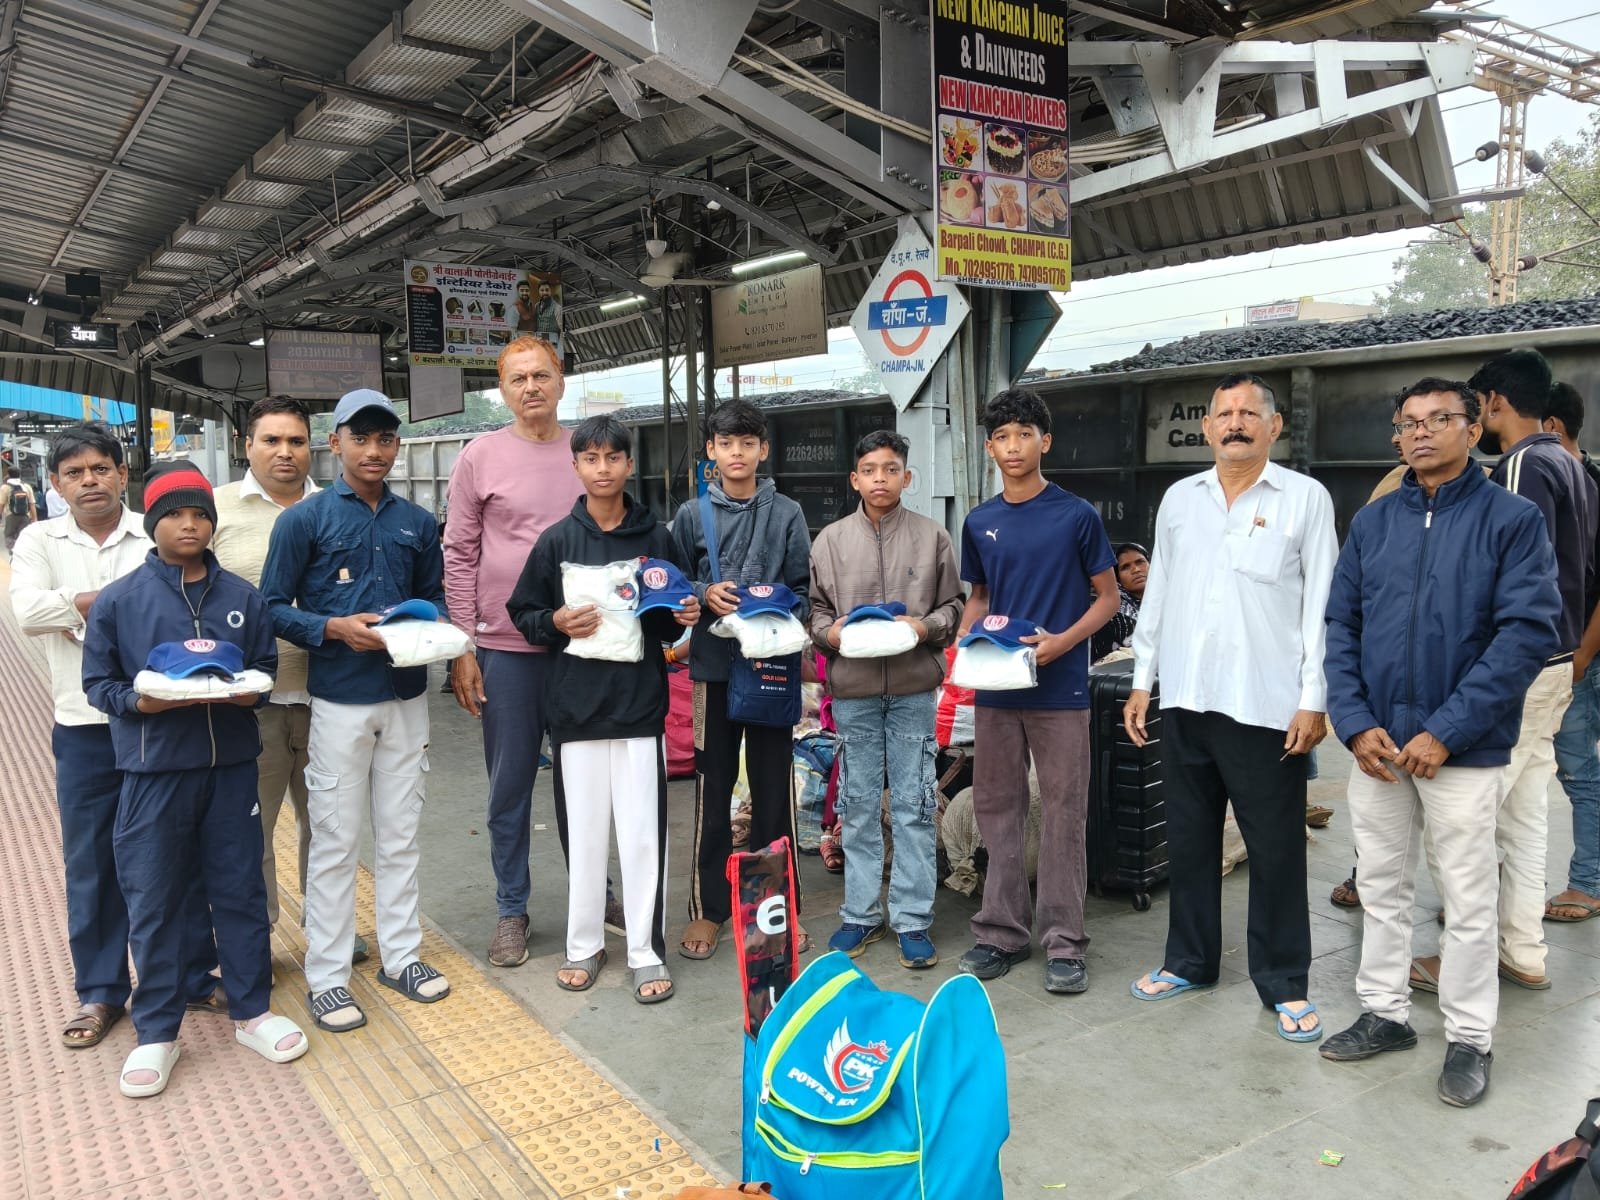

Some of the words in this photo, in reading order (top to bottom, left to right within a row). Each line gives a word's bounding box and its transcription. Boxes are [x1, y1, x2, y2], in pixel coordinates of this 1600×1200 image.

[971, 0, 1029, 38] KANCHAN
[1033, 3, 1065, 46] JUICE
[960, 35, 971, 69] &
[975, 32, 1046, 85] DAILYNEEDS
[939, 75, 967, 112] NEW
[968, 80, 1023, 122] KANCHAN
[1023, 92, 1067, 131] BAKERS
[941, 229, 975, 251] Barpali
[976, 232, 1009, 256] Chowk,
[1010, 236, 1046, 259] CHAMPA
[746, 277, 786, 296] KONARK
[957, 276, 983, 285] SHREE
[986, 279, 1037, 289] ADVERTISING
[787, 1066, 835, 1104] POWER
